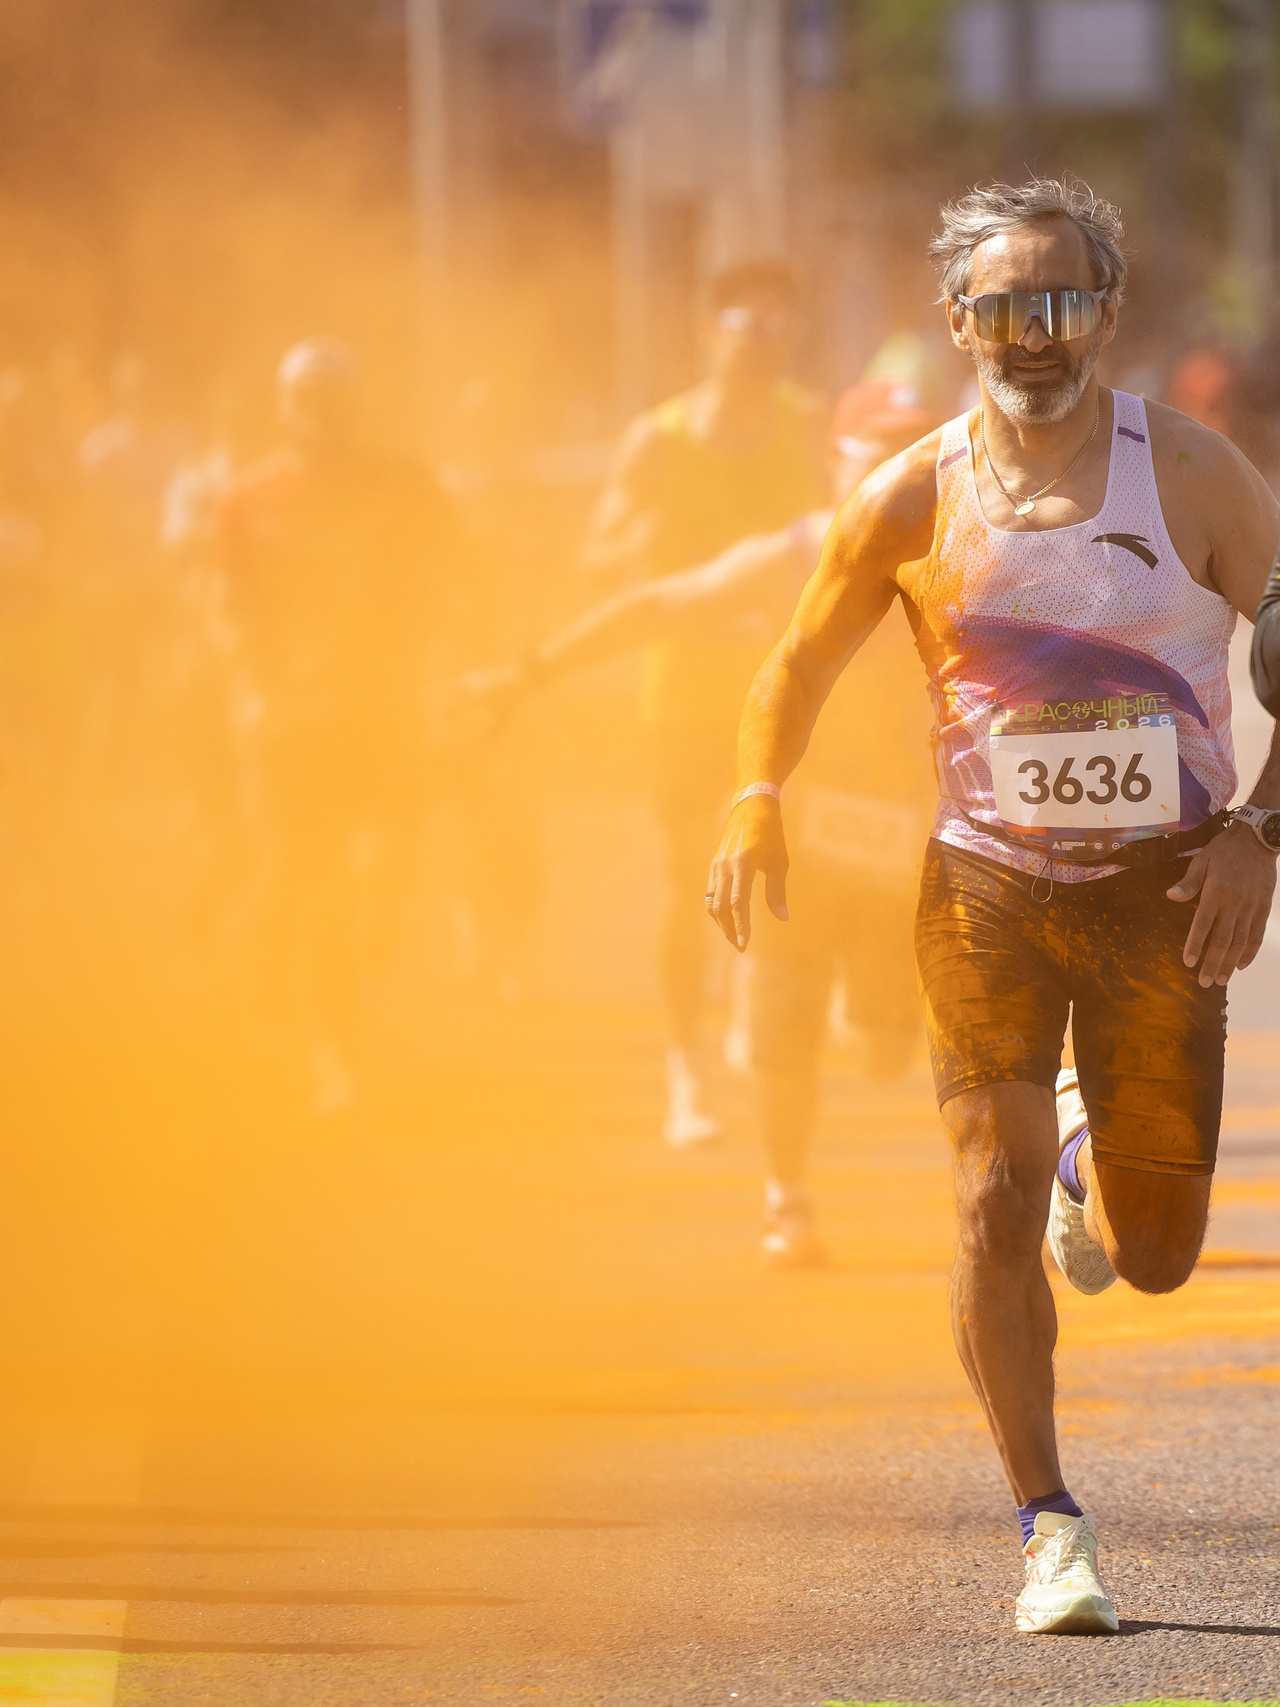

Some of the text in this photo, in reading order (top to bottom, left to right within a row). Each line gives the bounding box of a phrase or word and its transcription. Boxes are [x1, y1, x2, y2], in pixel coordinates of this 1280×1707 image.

[1005, 694, 1159, 724] КРАСОЧНЫЙ
[1094, 714, 1172, 732] 2026
[1017, 753, 1152, 805] 3636
